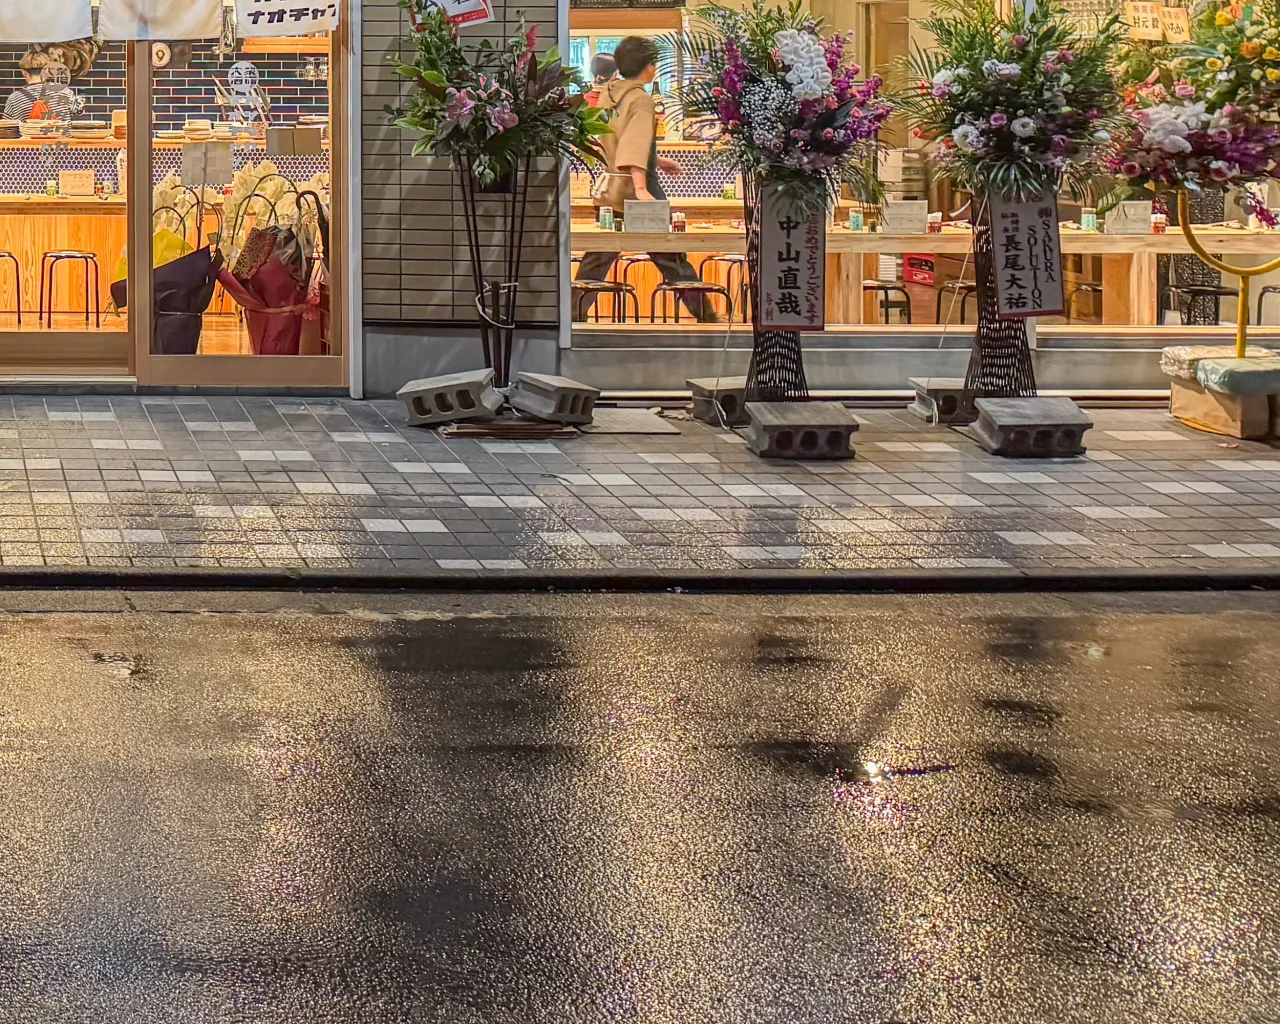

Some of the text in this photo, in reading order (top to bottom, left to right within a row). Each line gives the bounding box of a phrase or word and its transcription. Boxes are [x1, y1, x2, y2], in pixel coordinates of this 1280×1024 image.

[775, 216, 801, 315] 中山直哉
[1027, 225, 1042, 309] SOLUTION
